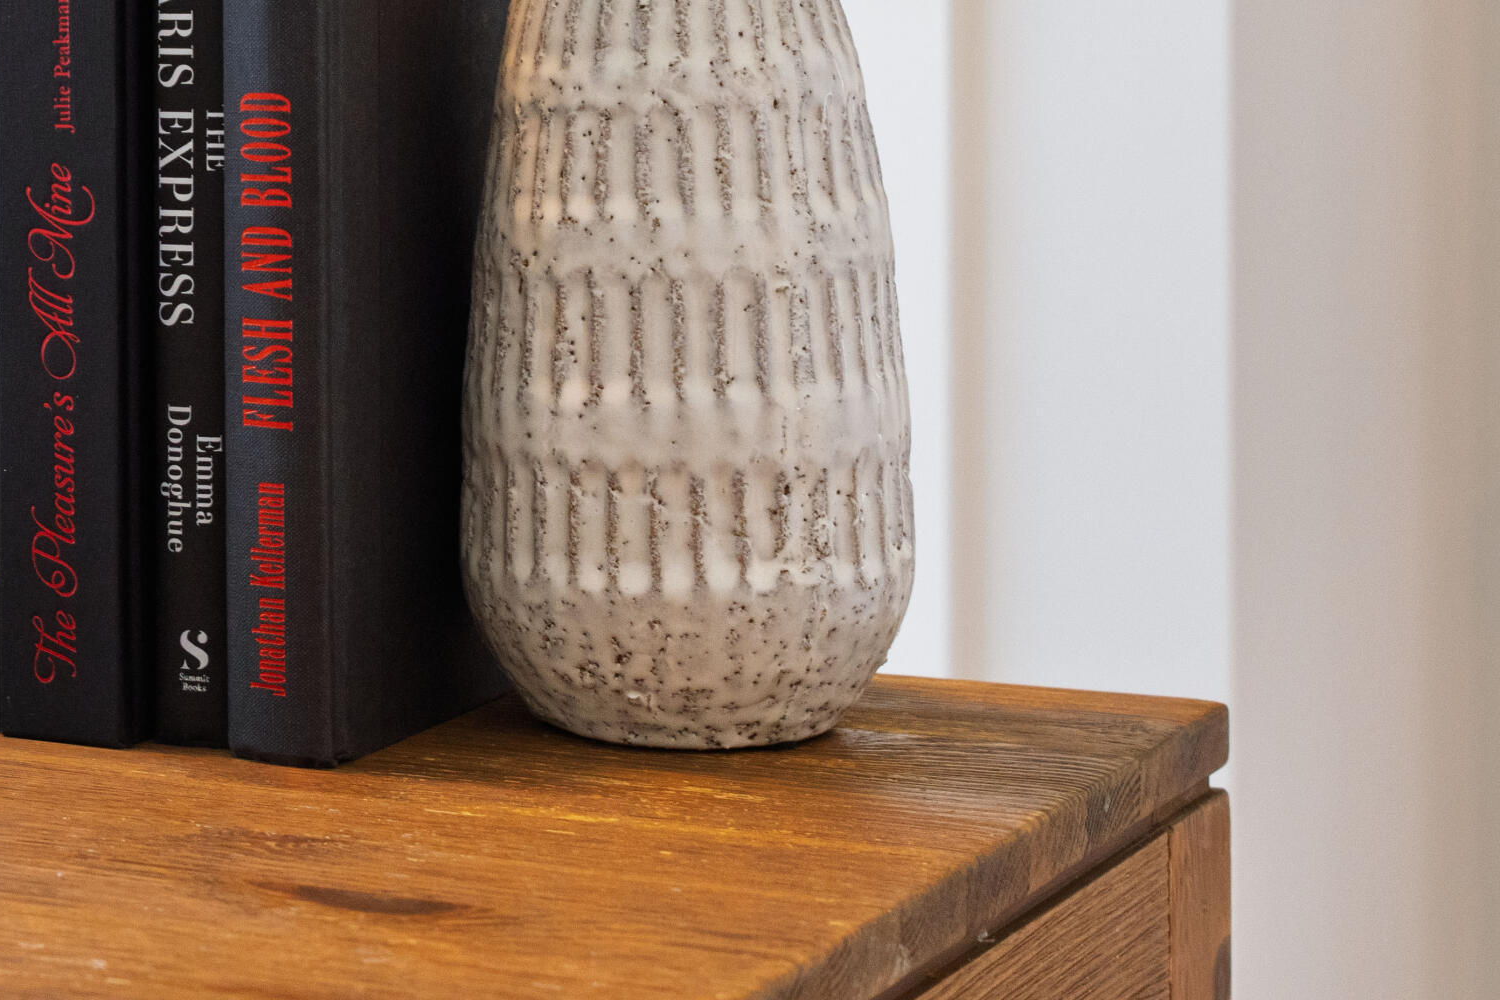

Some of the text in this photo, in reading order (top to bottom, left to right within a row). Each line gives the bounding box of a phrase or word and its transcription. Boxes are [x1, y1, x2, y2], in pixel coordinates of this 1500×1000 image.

[54, 86, 75, 133] Julie
[158, 108, 195, 327] EXPRESS
[239, 92, 293, 433] FLESH AND BLOOD
[24, 162, 96, 684] The Pleasure's All Mine
[160, 403, 192, 553] Donoghue
[196, 434, 223, 526] Emma
[250, 481, 286, 697] Jonathan Kellerman
[182, 682, 207, 692] Books
